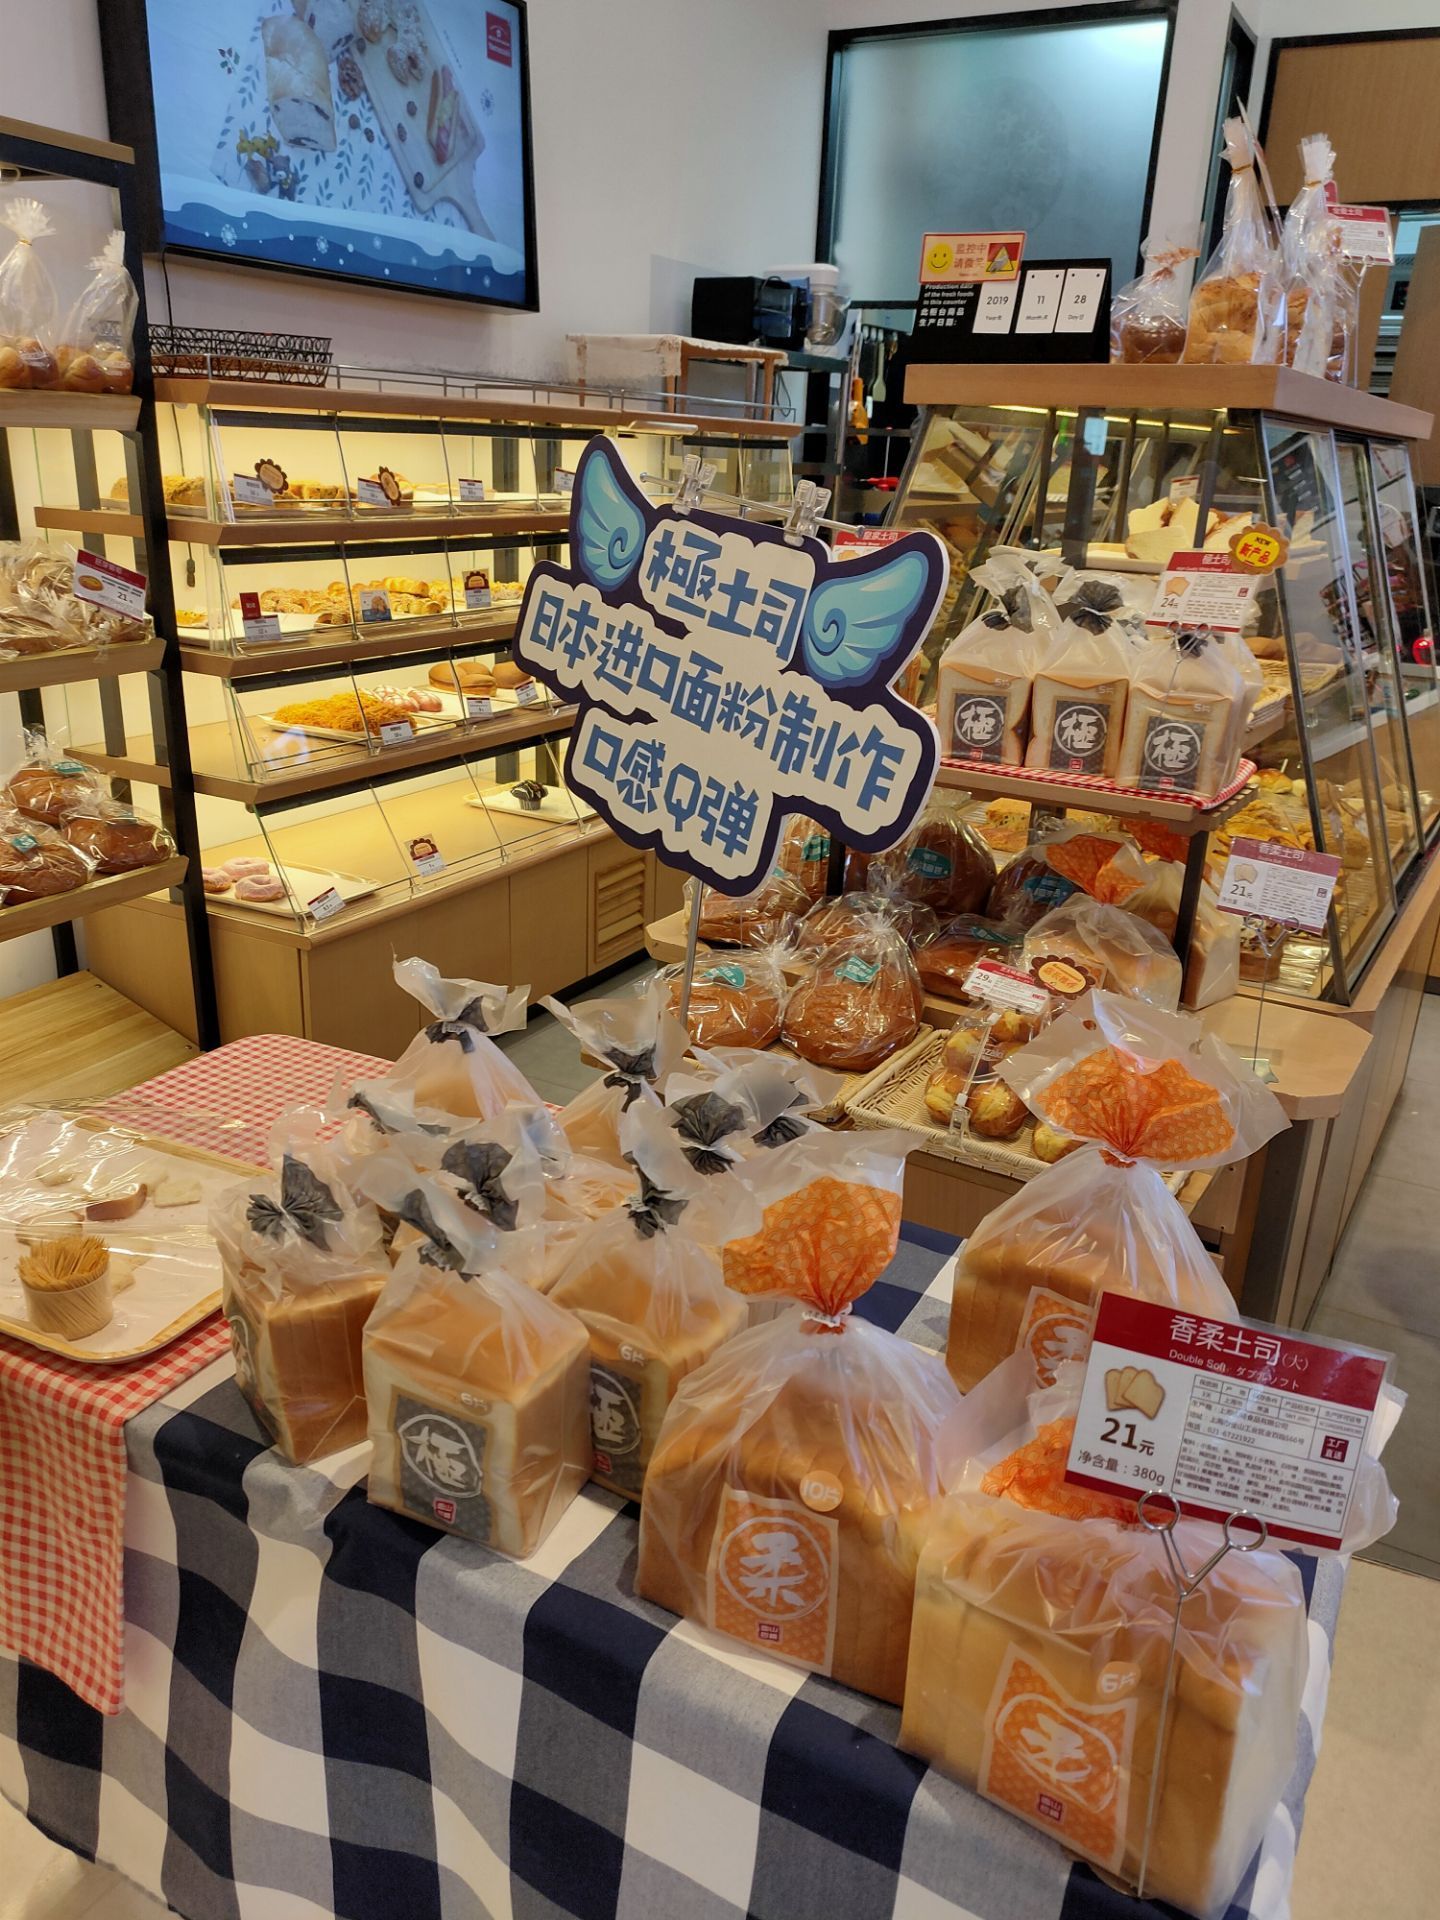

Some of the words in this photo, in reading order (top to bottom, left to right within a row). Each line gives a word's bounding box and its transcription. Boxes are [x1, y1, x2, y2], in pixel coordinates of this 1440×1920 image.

[956, 243, 988, 255] 监控中
[986, 296, 1009, 305] 2019
[1037, 295, 1045, 305] 11
[1074, 294, 1087, 304] 28
[1254, 536, 1272, 546] NEW
[1239, 543, 1272, 565] 新产品
[645, 528, 807, 662] 極土司
[529, 589, 905, 812] 日本进口面粉制作
[1061, 712, 1099, 749] 極
[1151, 730, 1194, 768] 極
[581, 723, 760, 858] 口感Q弹
[1170, 1315, 1281, 1366] 香柔土司
[1169, 1349, 1204, 1366] Double
[1206, 1358, 1226, 1373] Soft
[1100, 1417, 1155, 1456] 21元
[1327, 1438, 1346, 1448] 工厂
[1325, 1449, 1343, 1460] 直送
[803, 1479, 841, 1504] 10片
[738, 1531, 809, 1607] 柔
[1101, 1671, 1137, 1694] 6片
